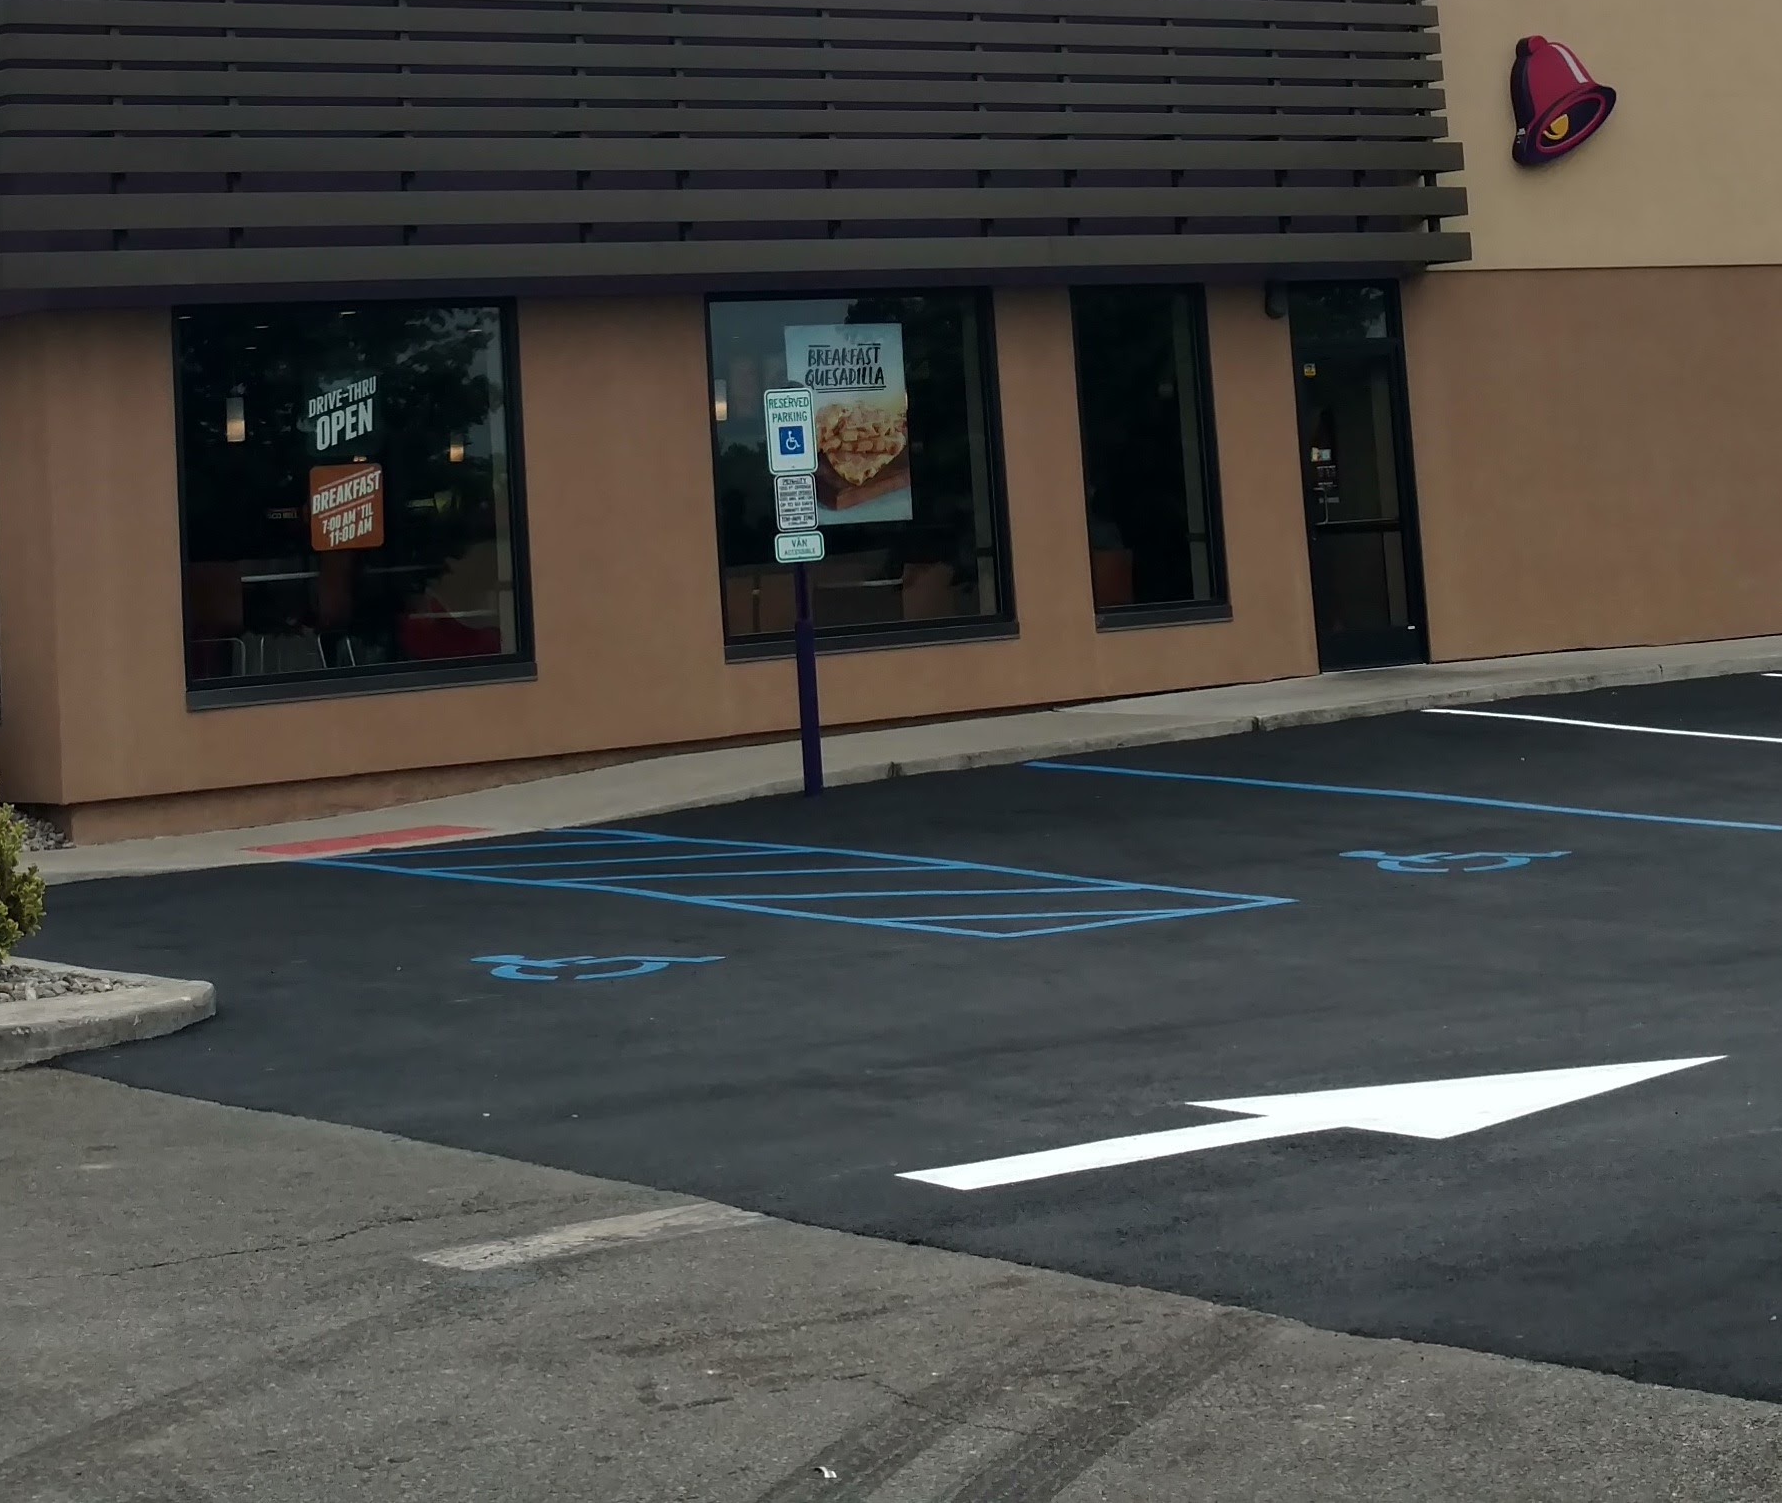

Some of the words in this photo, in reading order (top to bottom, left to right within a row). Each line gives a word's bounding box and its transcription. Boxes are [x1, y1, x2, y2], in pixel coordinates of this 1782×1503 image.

[808, 347, 881, 367] BREAKFAST
[804, 367, 884, 390] QUESADILLA
[308, 375, 377, 418] DRIVE-THRU
[768, 397, 809, 409] RESERVED
[316, 398, 373, 450] OPEN
[772, 411, 807, 423] PARKING
[312, 470, 381, 515] BREAKFAST
[322, 516, 341, 534] 7:00
[342, 510, 356, 527] AM
[329, 526, 355, 547] 11:00
[357, 517, 373, 537] AM
[791, 539, 807, 547] VAN
